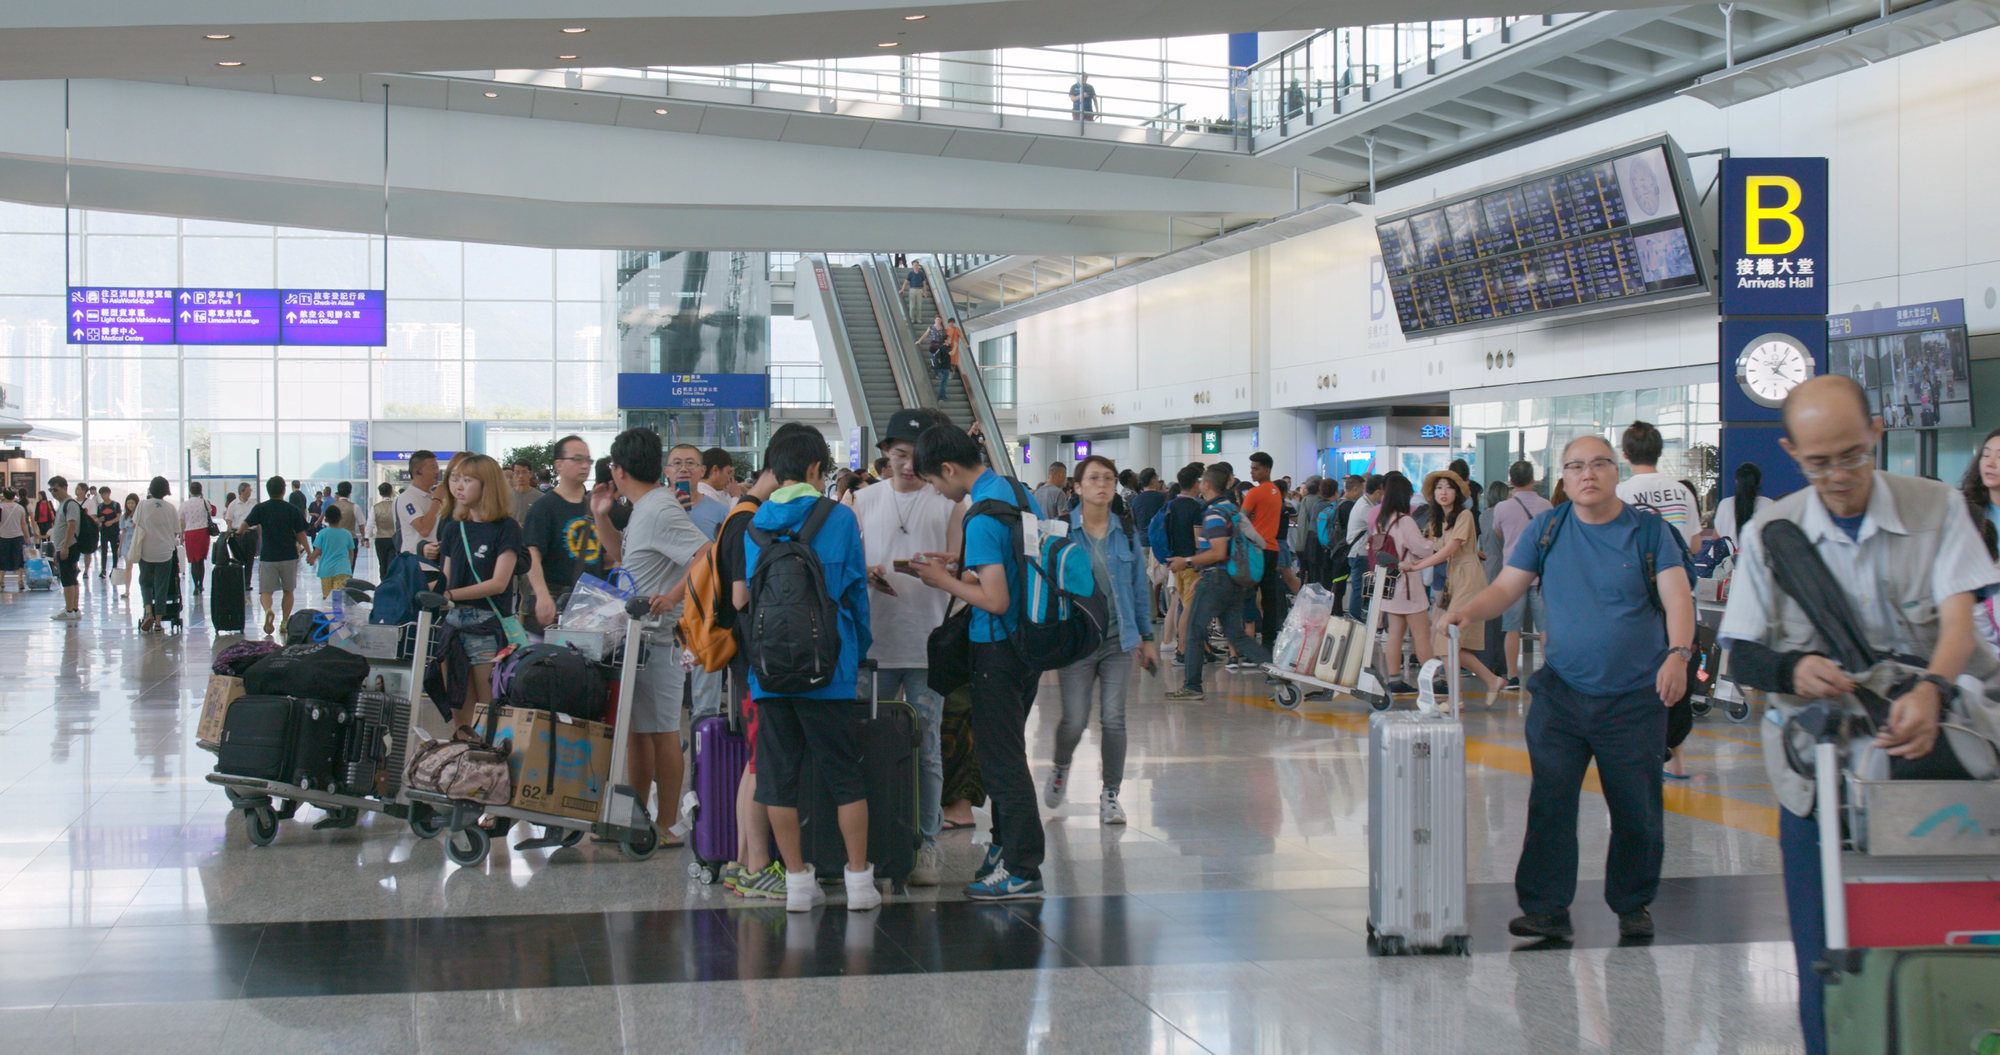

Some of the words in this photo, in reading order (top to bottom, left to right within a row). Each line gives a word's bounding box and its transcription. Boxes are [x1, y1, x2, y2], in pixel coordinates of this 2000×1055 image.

[1746, 176, 1804, 254] B
[1736, 258, 1814, 275] 接機大堂
[1370, 254, 1386, 321] B
[1737, 277, 1786, 289] Arrivals
[1789, 277, 1814, 289] Hall
[235, 292, 241, 305] 1
[1931, 307, 1940, 323] A
[1845, 318, 1851, 334] B
[672, 375, 682, 383] L7
[672, 387, 682, 395] L6
[1633, 488, 1687, 503] WISELY
[522, 784, 541, 800] 62
